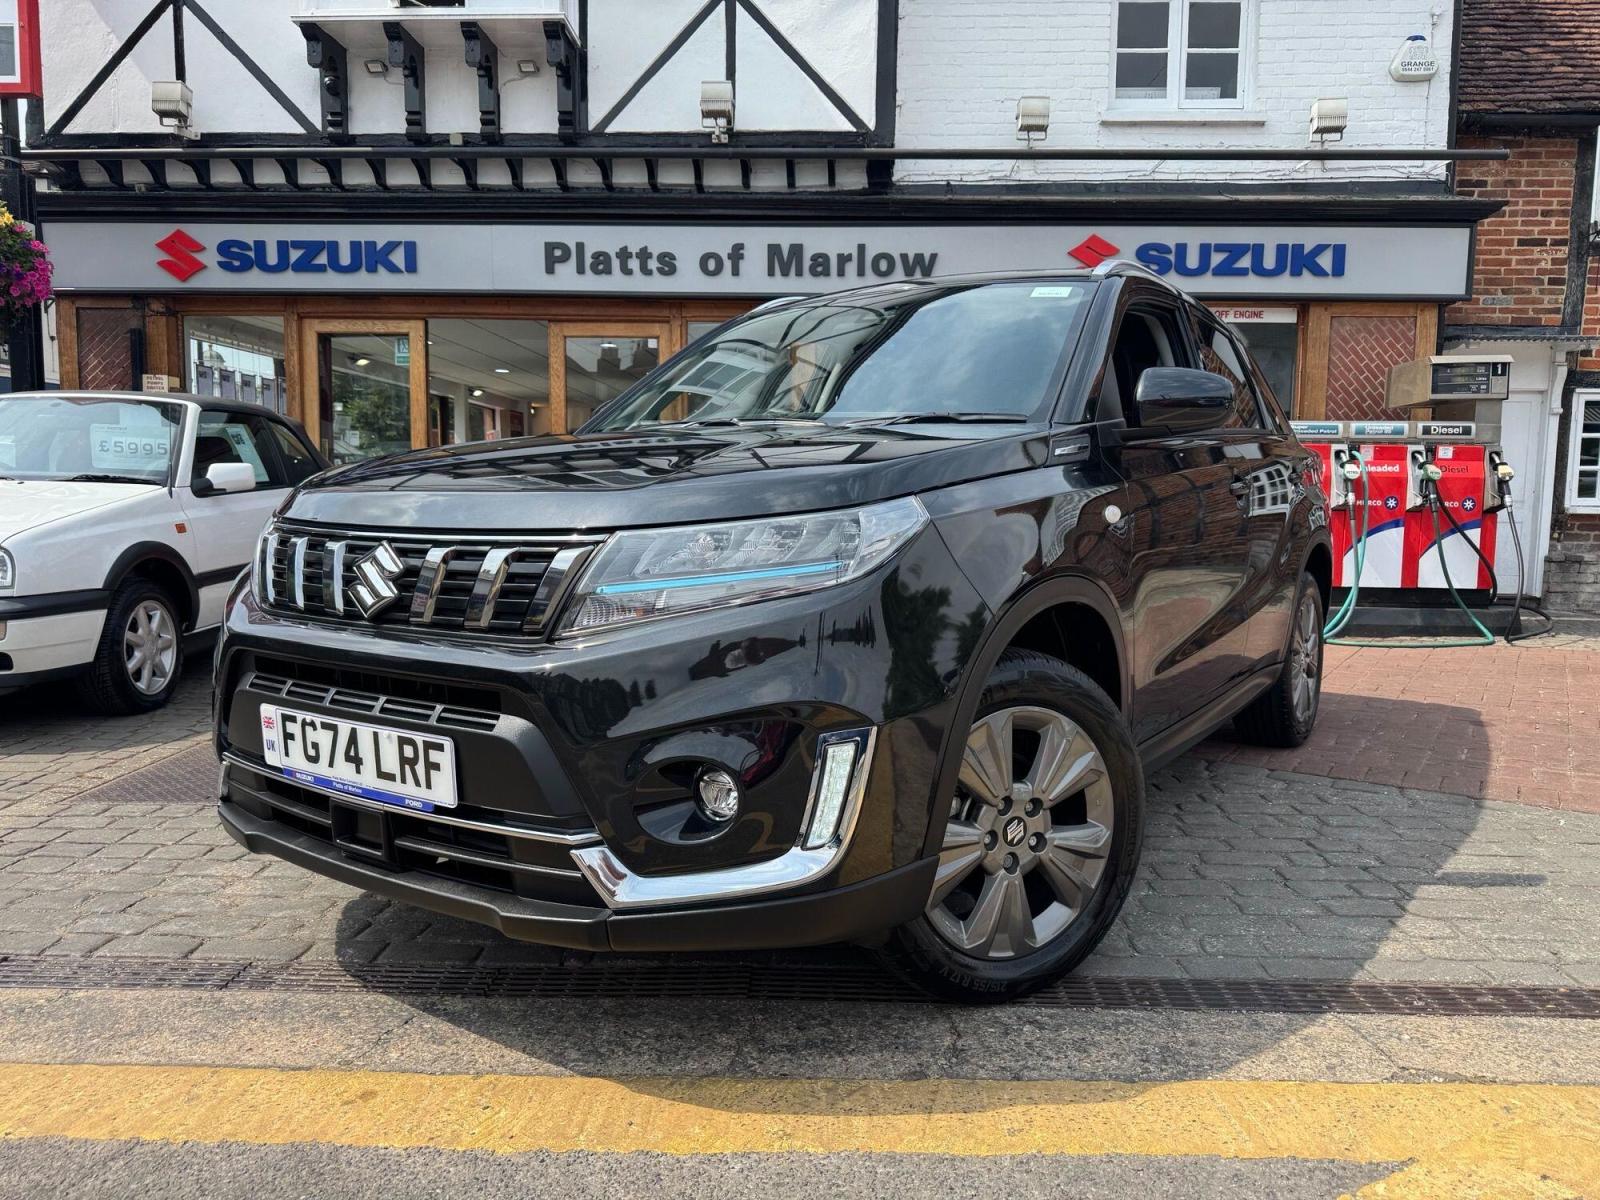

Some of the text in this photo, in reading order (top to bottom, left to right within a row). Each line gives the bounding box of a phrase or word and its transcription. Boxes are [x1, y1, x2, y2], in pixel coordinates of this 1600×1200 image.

[216, 239, 417, 273] SUZUKI
[543, 242, 938, 277] Platts of Marlow
[1135, 242, 1347, 277] SUZUKI
[1215, 310, 1264, 318] OFF ENGINE
[1497, 364, 1502, 374] 1
[98, 440, 168, 456] £5995
[266, 739, 276, 752] UK
[280, 712, 445, 790] FG74 LRF
[295, 772, 314, 784] SUZUKI
[406, 798, 423, 808] FORD
